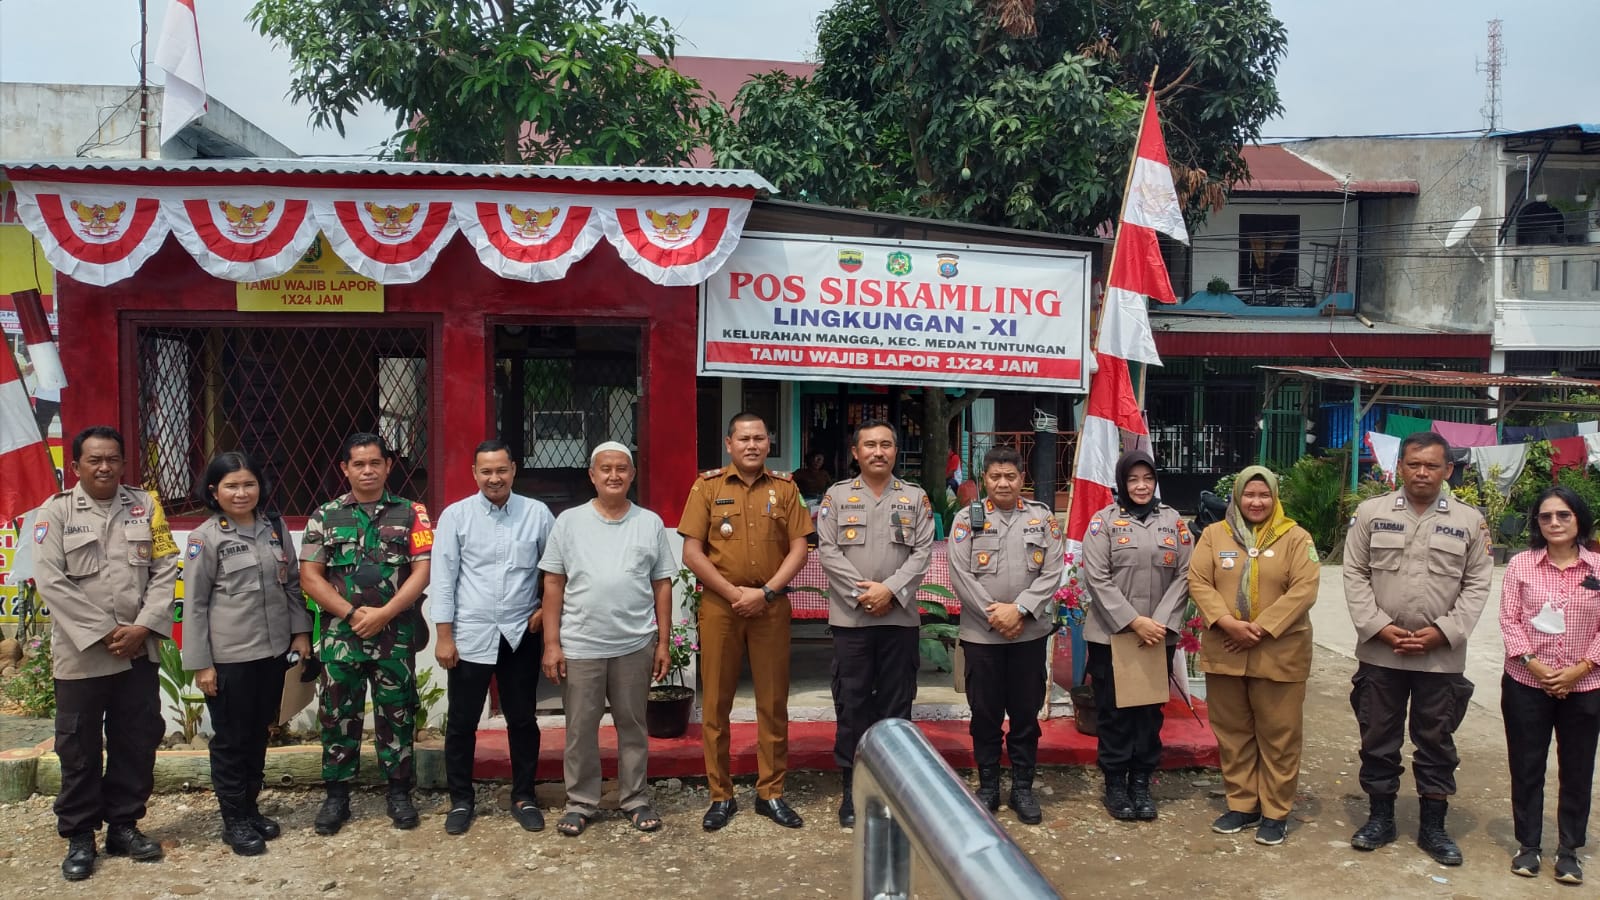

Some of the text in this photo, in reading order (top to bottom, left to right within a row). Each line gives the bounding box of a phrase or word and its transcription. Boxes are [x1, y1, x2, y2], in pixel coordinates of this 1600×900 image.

[284, 280, 326, 291] WAJIB
[330, 280, 377, 292] LAPOR
[728, 272, 1062, 317] POS SISKAMLING
[281, 294, 343, 305] 1X24 JAM
[774, 307, 964, 334] LINGKUNGAN
[988, 318, 1017, 337] XI
[722, 328, 1066, 355] KELURAHAN MANGGA, KEC. MEDAN TUNTUNGAN
[750, 347, 1039, 374] TAMU WAJIB LAPOR 1X24 JAM
[891, 504, 916, 512] POLRI
[1435, 525, 1465, 539] POLRI
